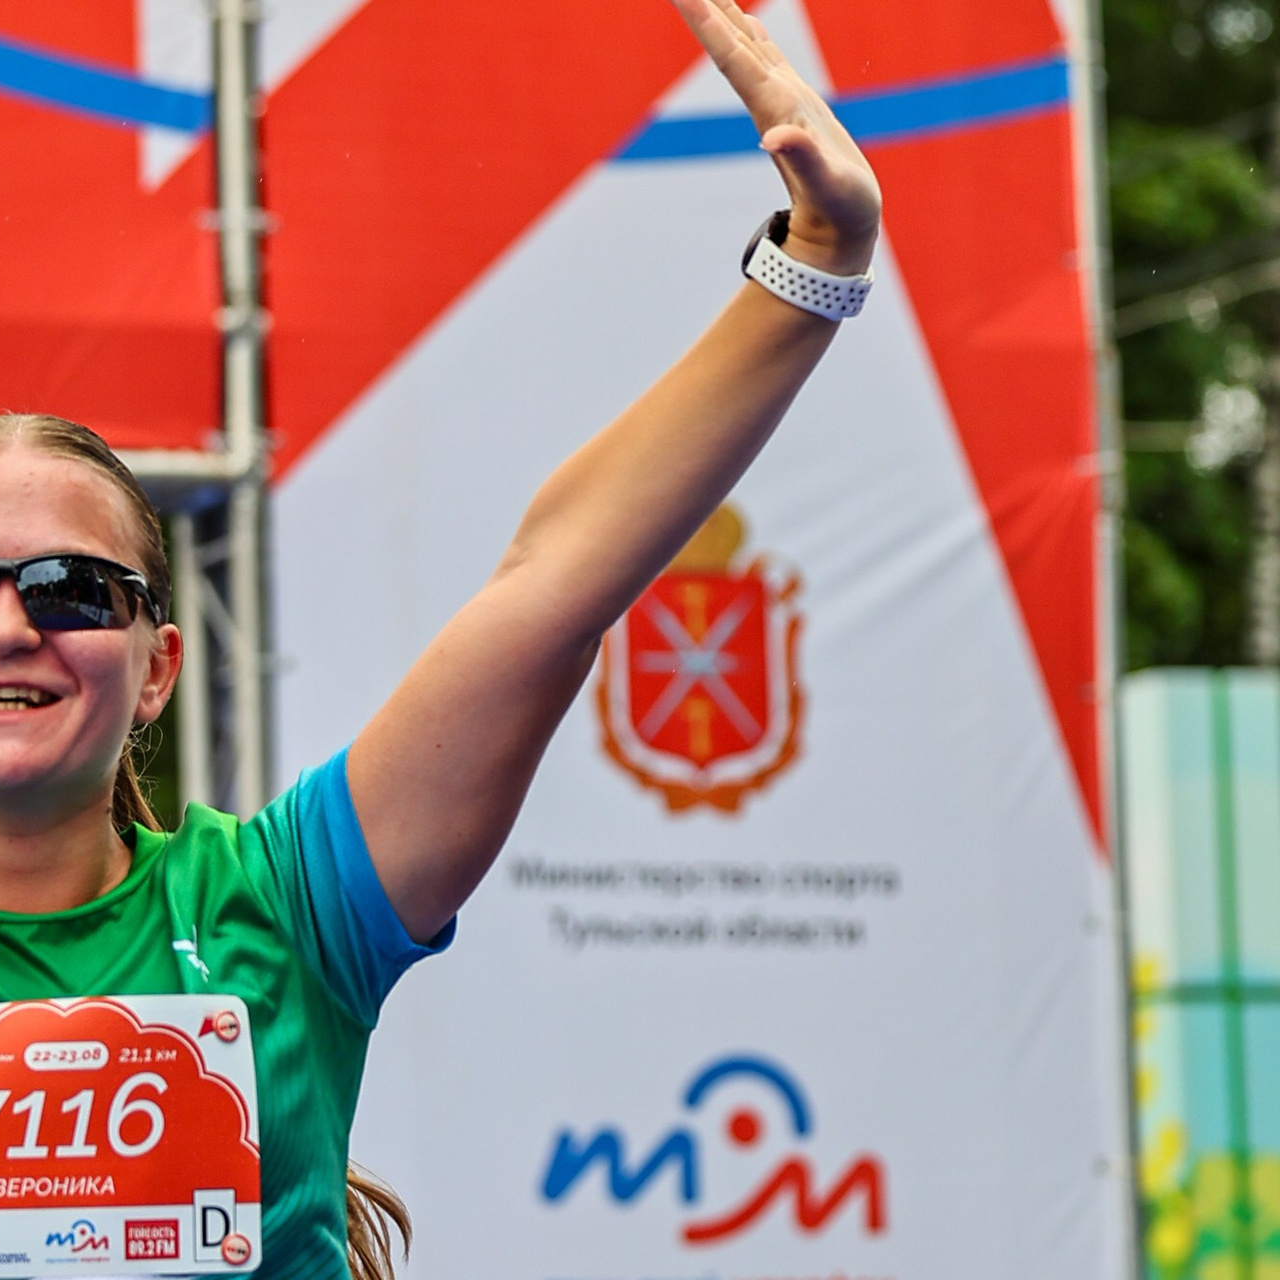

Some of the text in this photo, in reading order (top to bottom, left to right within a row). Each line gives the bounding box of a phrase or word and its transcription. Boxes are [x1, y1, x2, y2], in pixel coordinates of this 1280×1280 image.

[31, 1046, 102, 1064] 22-23.08
[118, 1047, 152, 1063] 21.1
[201, 1206, 231, 1248] D
